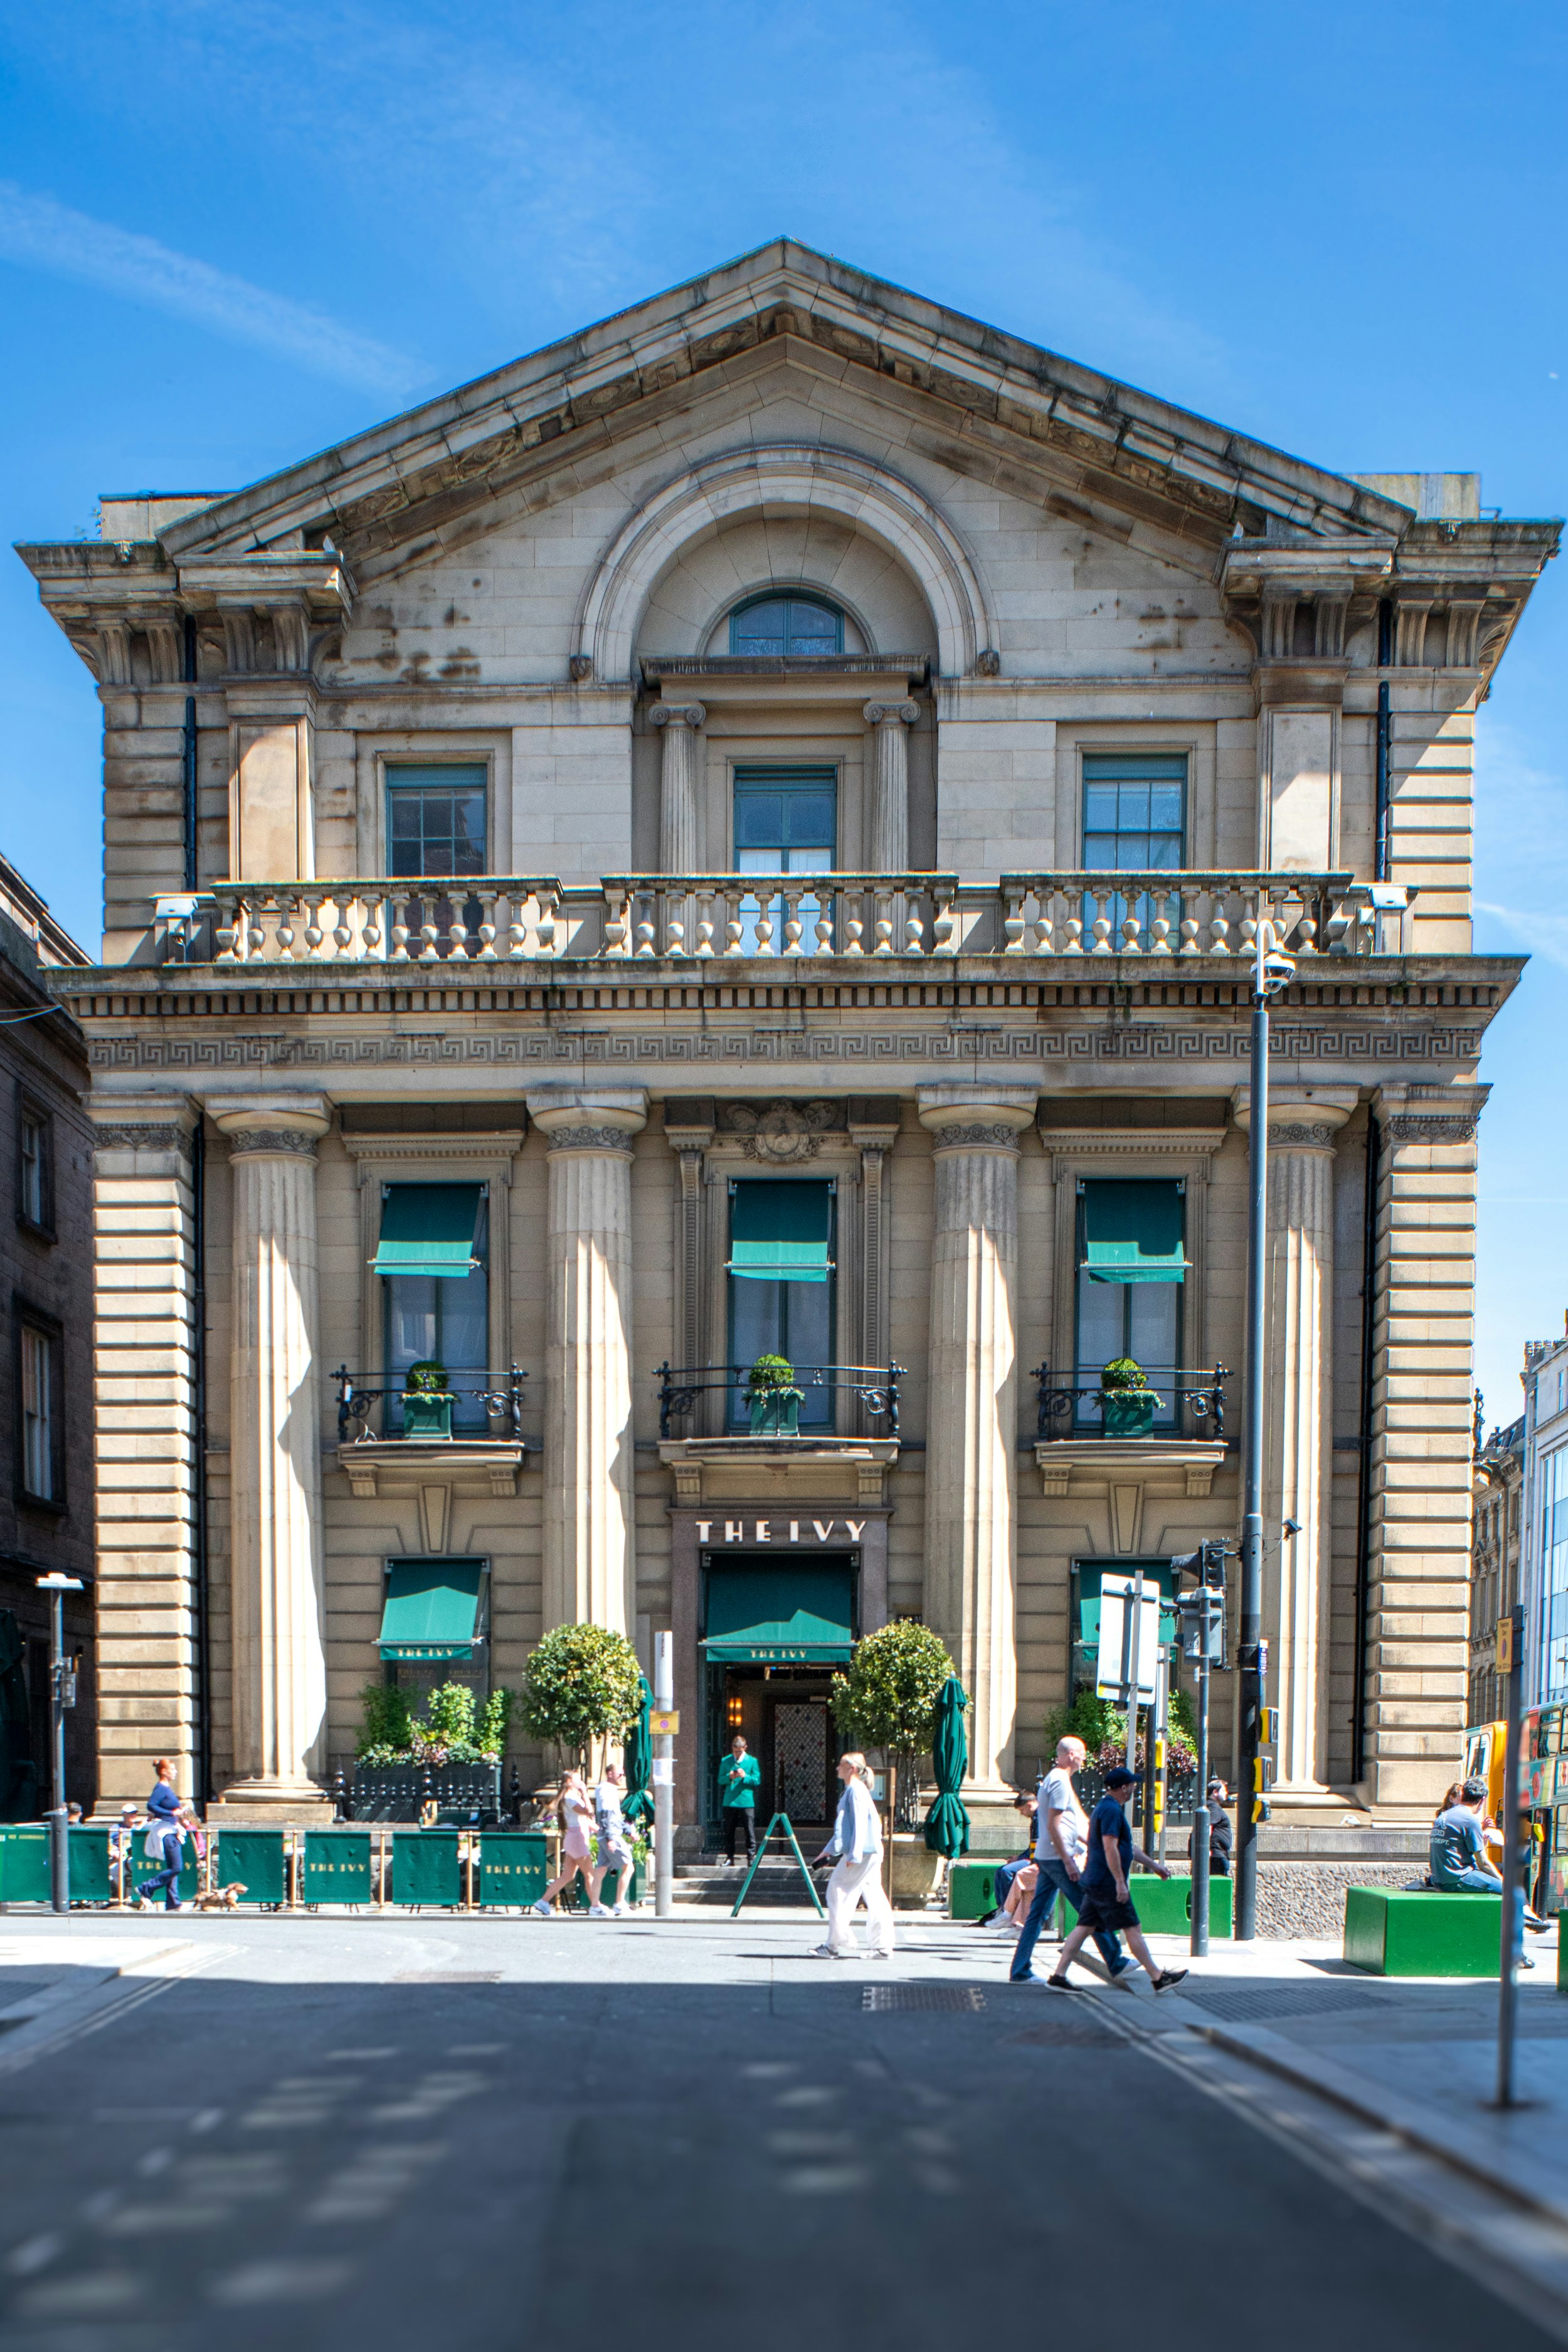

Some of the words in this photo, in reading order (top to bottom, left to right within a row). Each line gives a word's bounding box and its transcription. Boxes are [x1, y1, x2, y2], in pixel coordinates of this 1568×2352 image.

[695, 1520, 771, 1542] THE
[790, 1520, 867, 1542] IVY
[398, 1648, 422, 1657] THE
[428, 1648, 453, 1657] IVY
[750, 1650, 775, 1658] THE
[781, 1650, 807, 1658] IVY
[310, 1863, 334, 1872] THE
[340, 1863, 366, 1872] IVY
[485, 1865, 510, 1874] THE
[516, 1865, 541, 1875] IVY
